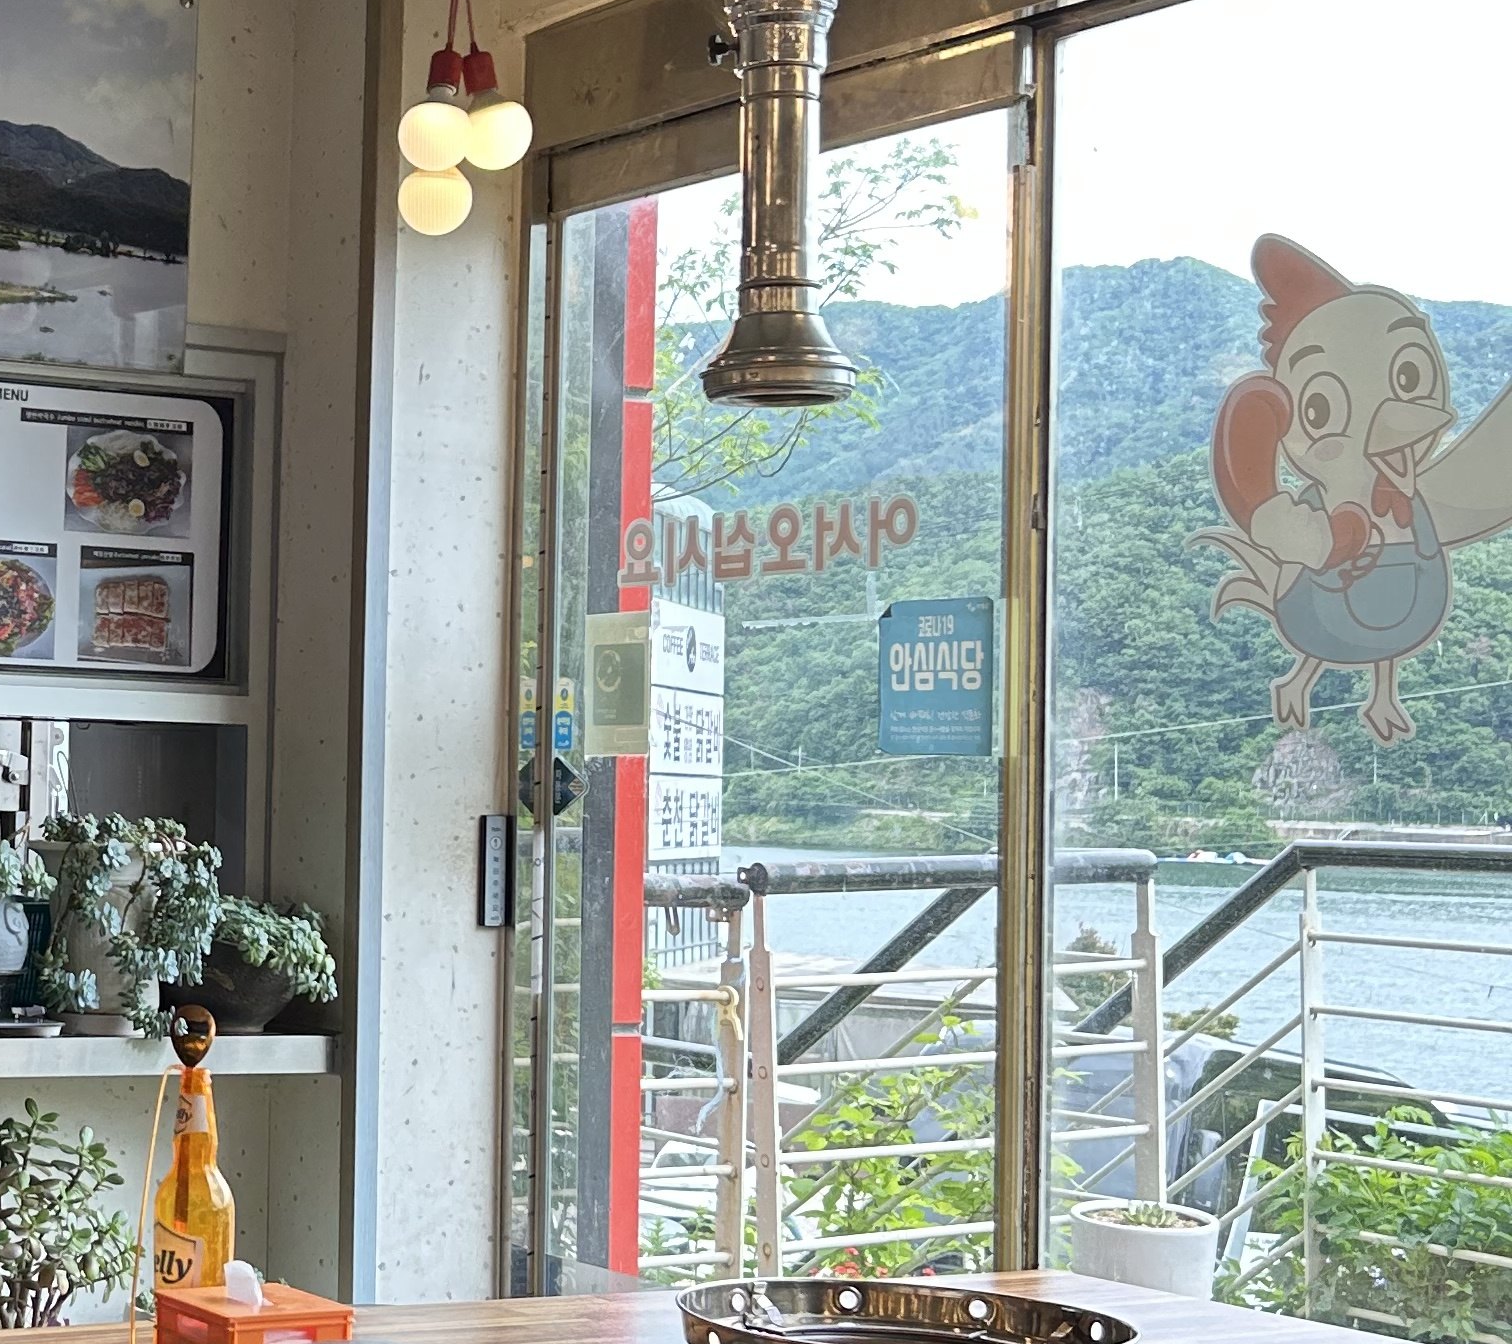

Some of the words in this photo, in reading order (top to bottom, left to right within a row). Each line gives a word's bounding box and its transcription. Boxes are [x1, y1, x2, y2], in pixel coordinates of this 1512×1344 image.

[918, 614, 955, 638] 코로나19
[889, 639, 985, 692] 안심식당
[662, 786, 683, 847] 춘천
[689, 790, 720, 848] 닭갈비
[155, 1248, 193, 1285] elly
